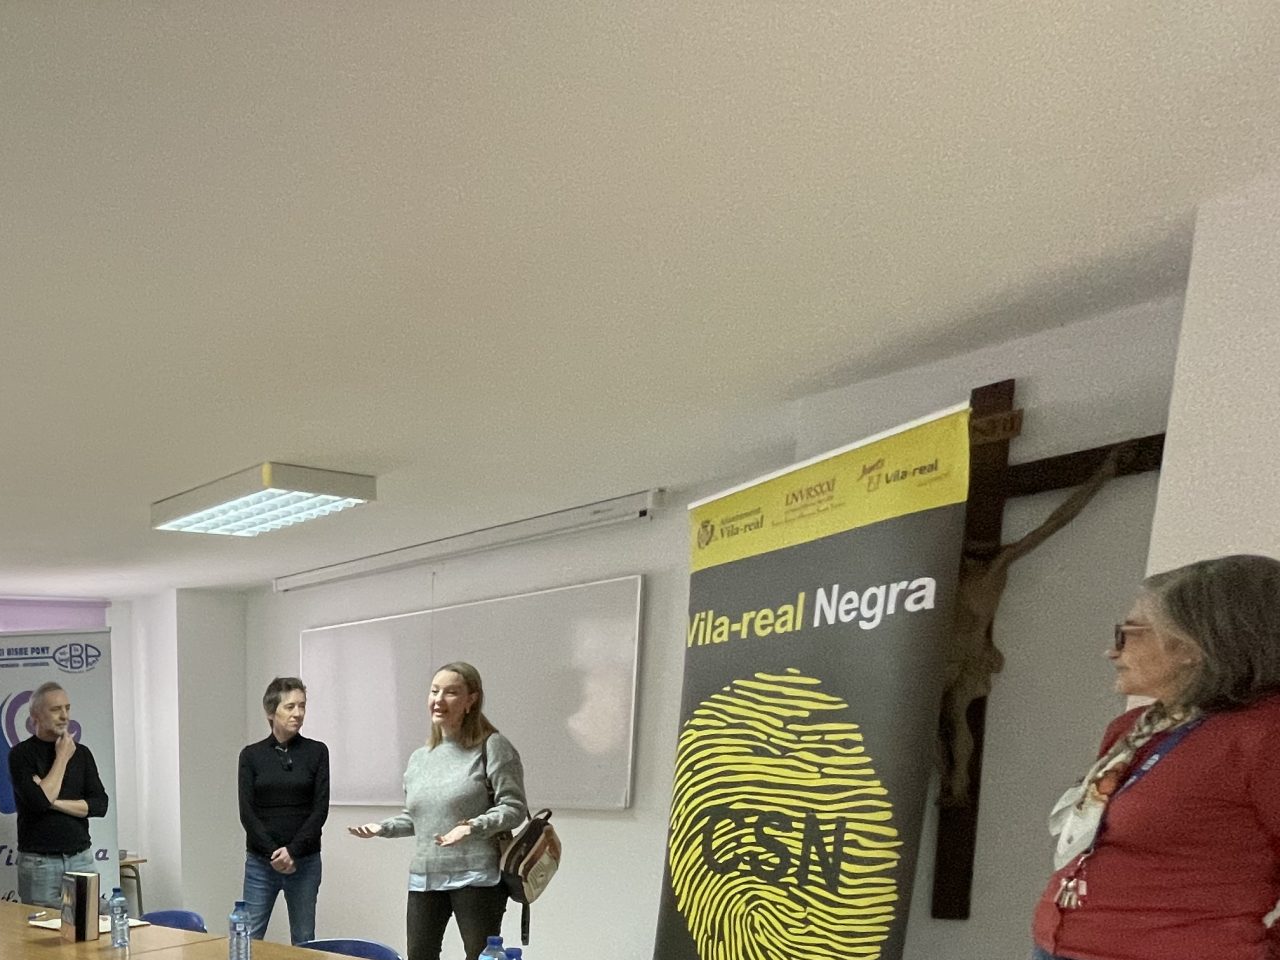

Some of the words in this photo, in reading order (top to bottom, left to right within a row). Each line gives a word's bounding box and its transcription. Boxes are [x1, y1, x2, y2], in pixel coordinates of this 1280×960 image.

[687, 592, 805, 648] Vila-real
[813, 576, 937, 631] Negra
[702, 806, 847, 892] CSN
